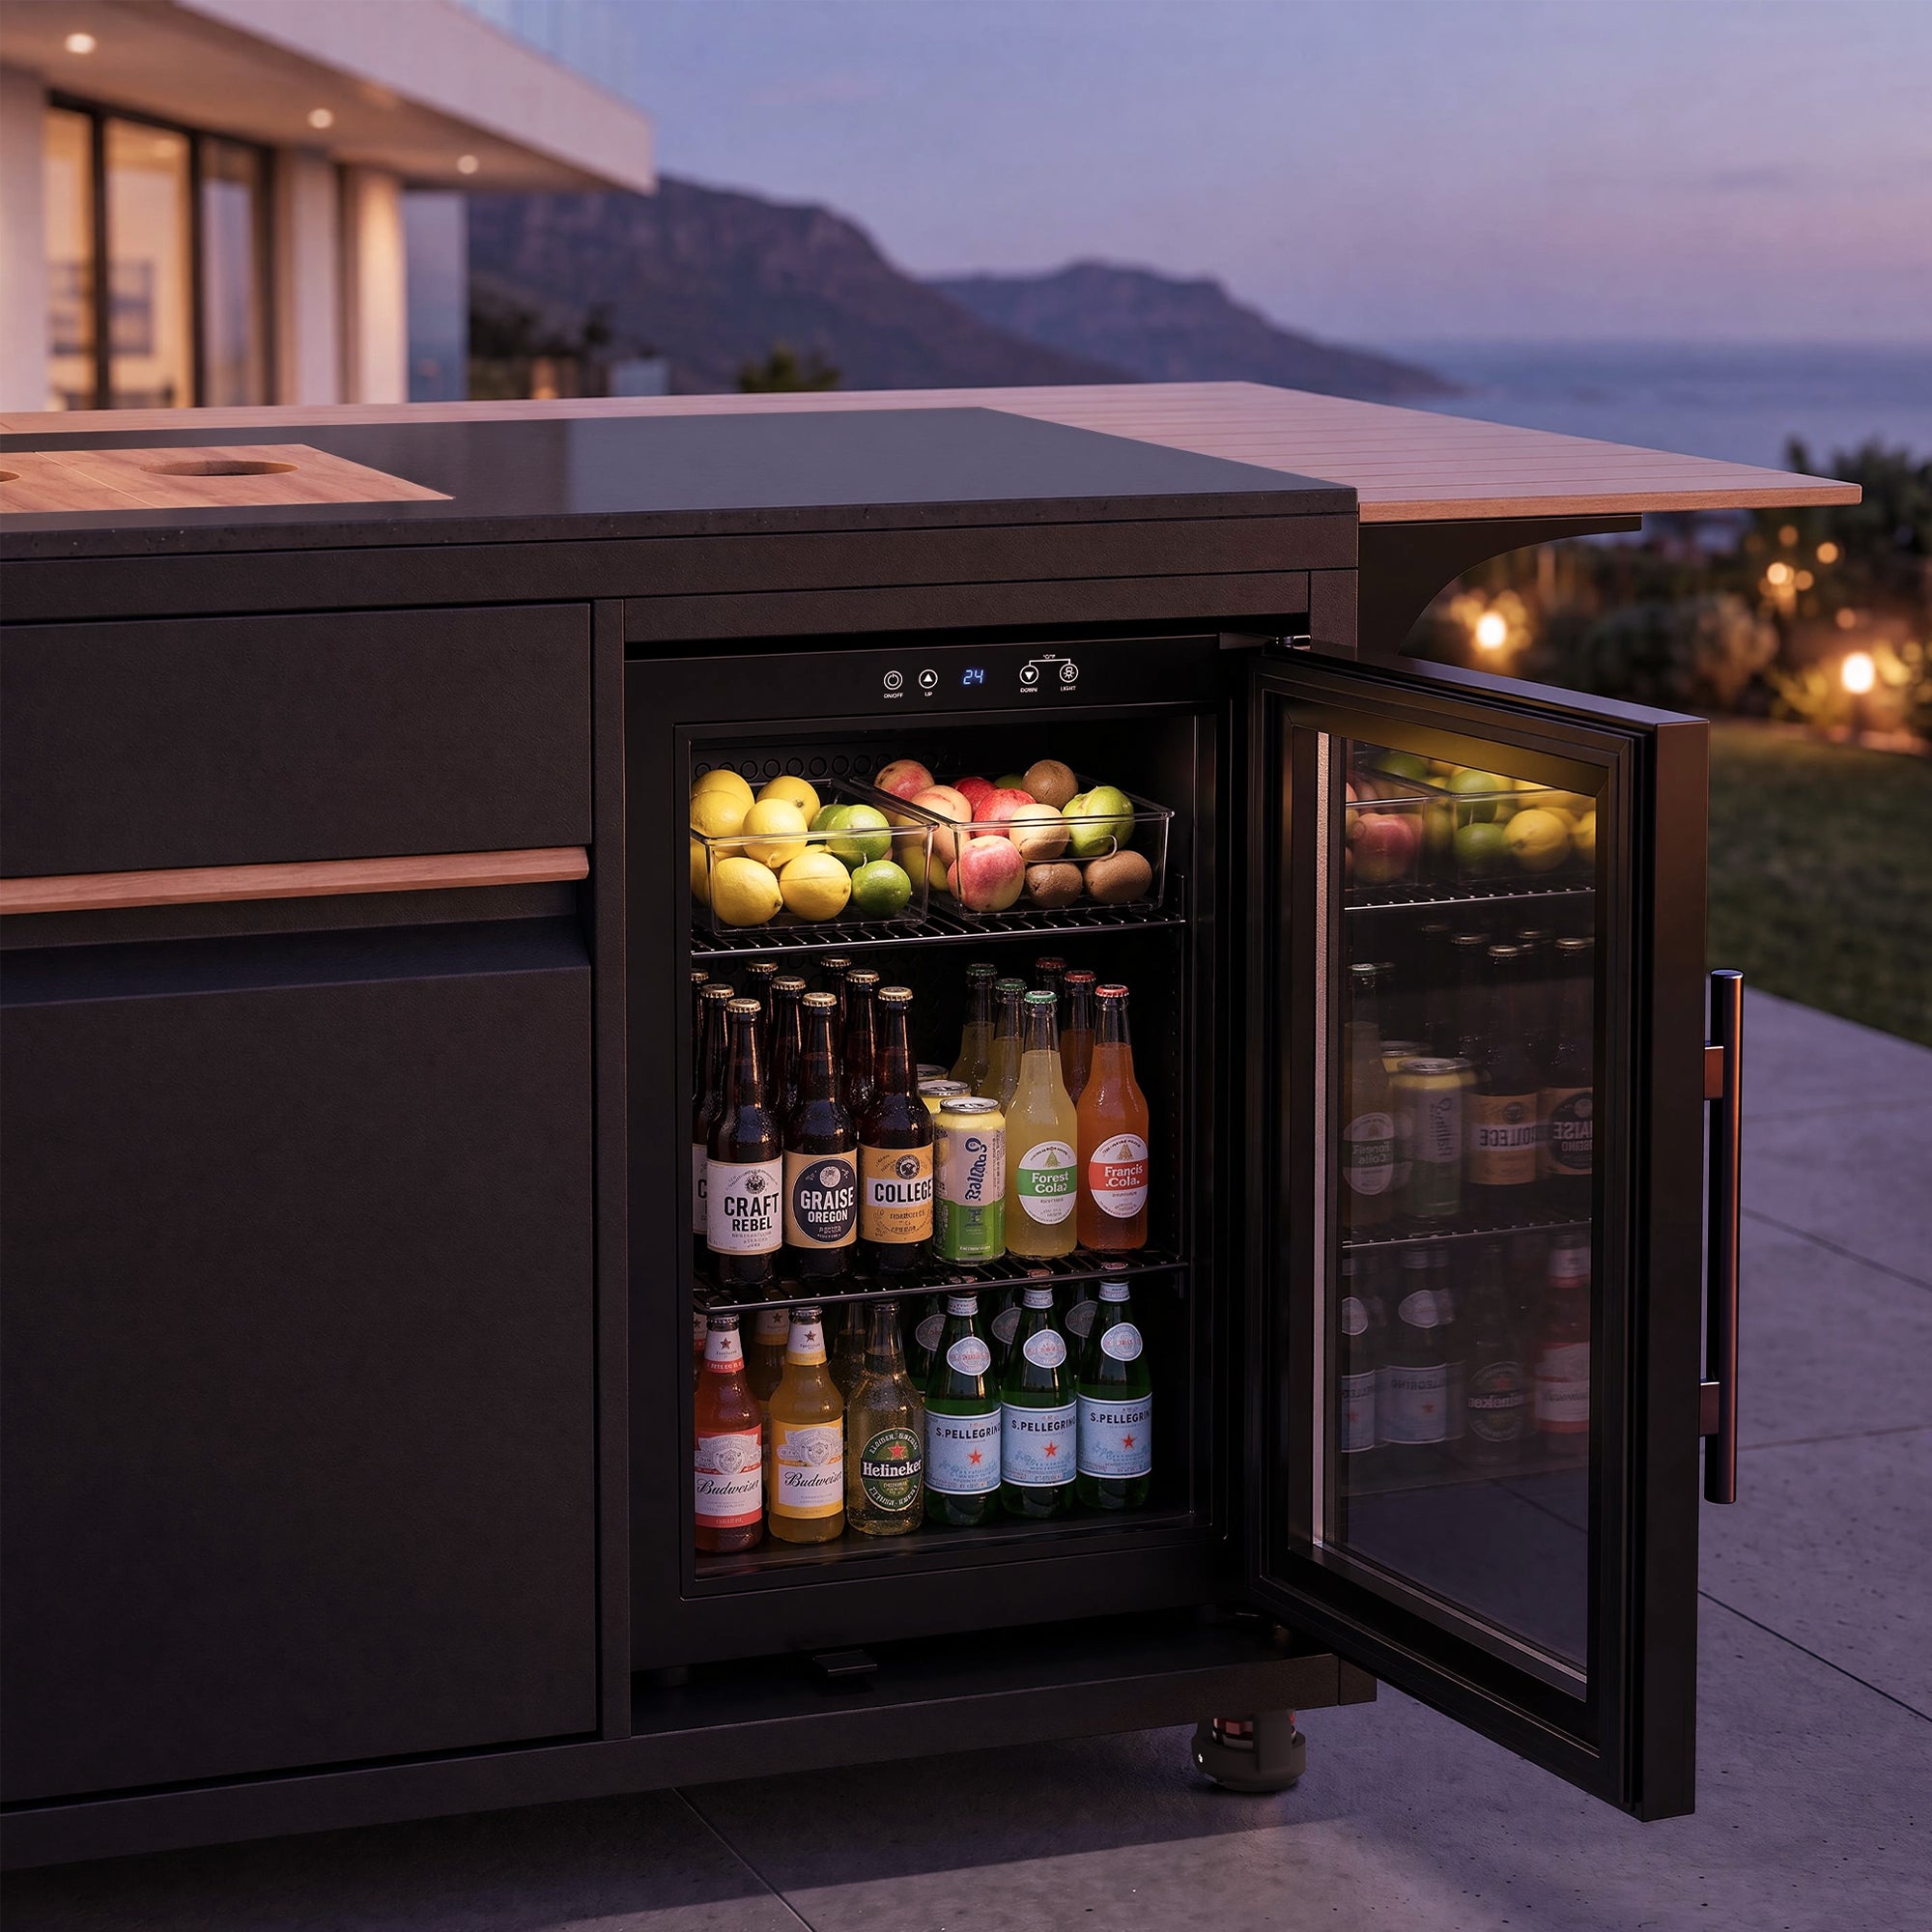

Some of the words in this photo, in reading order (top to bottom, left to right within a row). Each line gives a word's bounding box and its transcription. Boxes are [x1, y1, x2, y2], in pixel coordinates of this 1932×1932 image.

[963, 669, 983, 685] 24
[1032, 1172, 1068, 1183] Forest
[1104, 1164, 1143, 1178] Francis
[800, 1186, 854, 1210] GRAISE
[874, 1179, 932, 1203] COLLEGE
[724, 1192, 780, 1217] CRAFT
[732, 1216, 773, 1232] REBEL
[808, 1209, 848, 1224] OREGON
